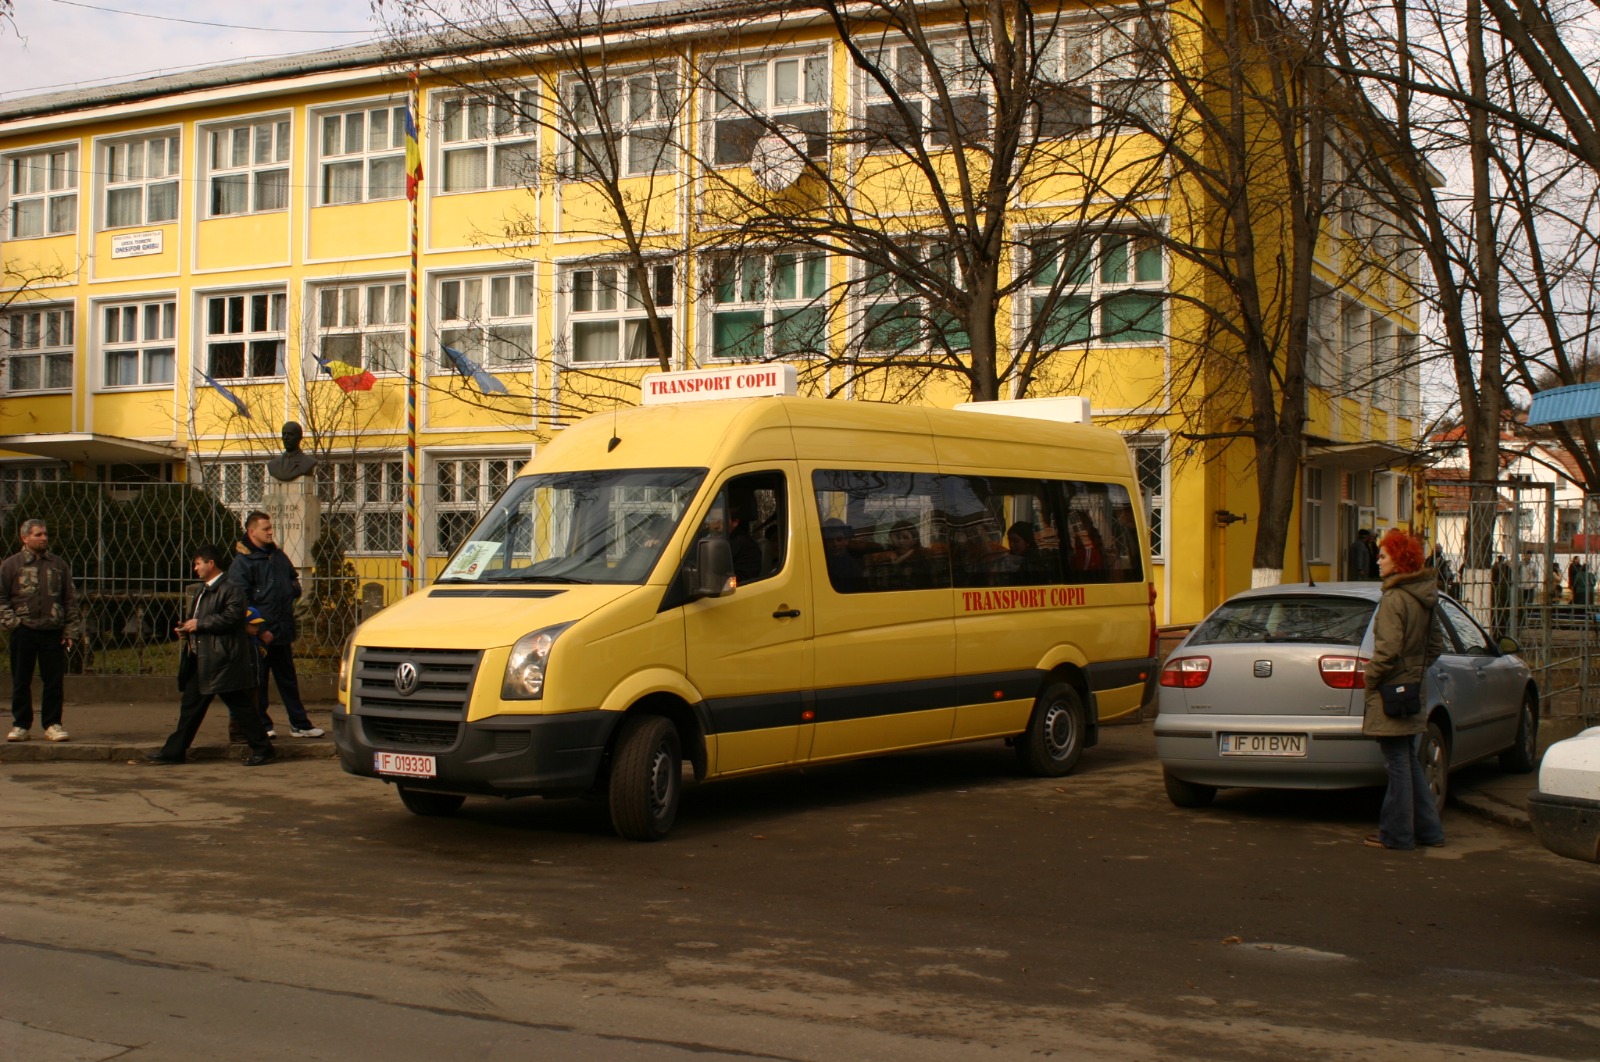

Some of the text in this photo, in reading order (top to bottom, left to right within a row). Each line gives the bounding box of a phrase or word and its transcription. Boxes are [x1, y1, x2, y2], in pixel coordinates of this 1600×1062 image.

[115, 245, 141, 253] ONISIFOR
[650, 372, 777, 395] TRANSPORT COPII
[962, 587, 1086, 611] TRANSPORT COPII
[1234, 736, 1301, 751] IF 01 BVN
[382, 754, 432, 773] IF 019330
